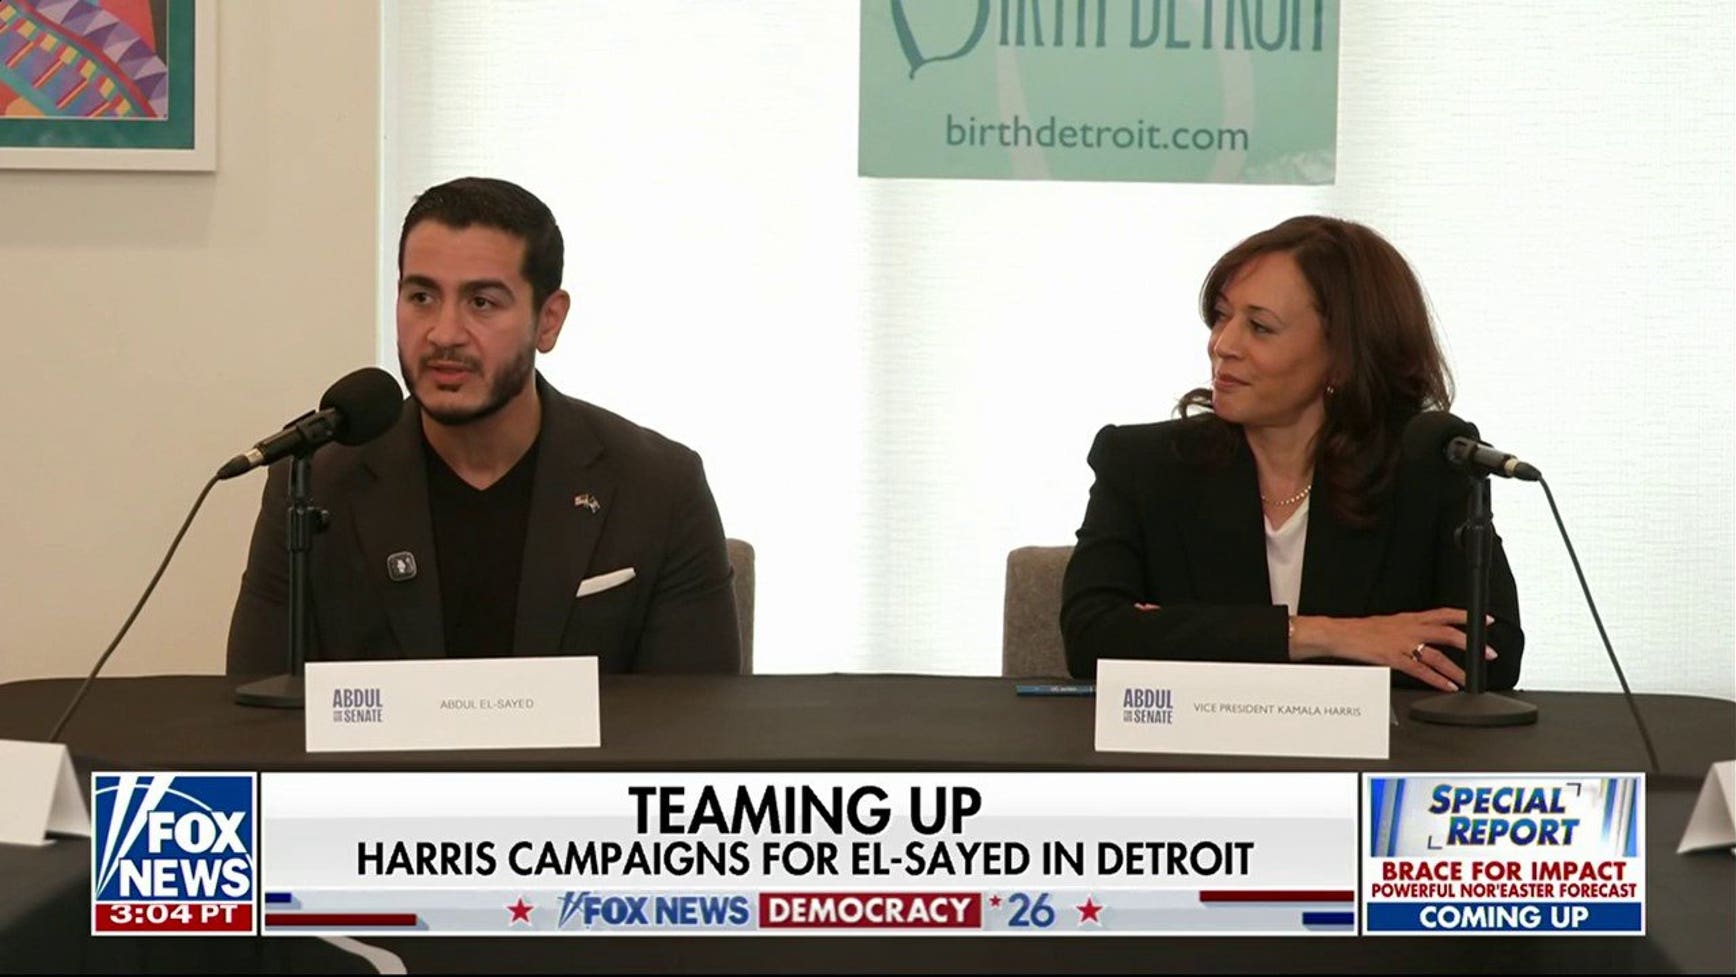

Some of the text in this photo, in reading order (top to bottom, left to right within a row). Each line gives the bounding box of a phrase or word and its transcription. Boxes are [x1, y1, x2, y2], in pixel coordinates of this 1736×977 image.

[945, 113, 1249, 151] birthdetroit.com
[332, 688, 383, 708] ABDUL
[439, 698, 535, 710] ABDUL EL-SAYED
[1123, 688, 1173, 709] ABDUL
[344, 708, 382, 723] SENATE
[1133, 709, 1172, 725] SENATE
[1193, 702, 1362, 716] VICE PRESIDENT KAMALA HARRIS
